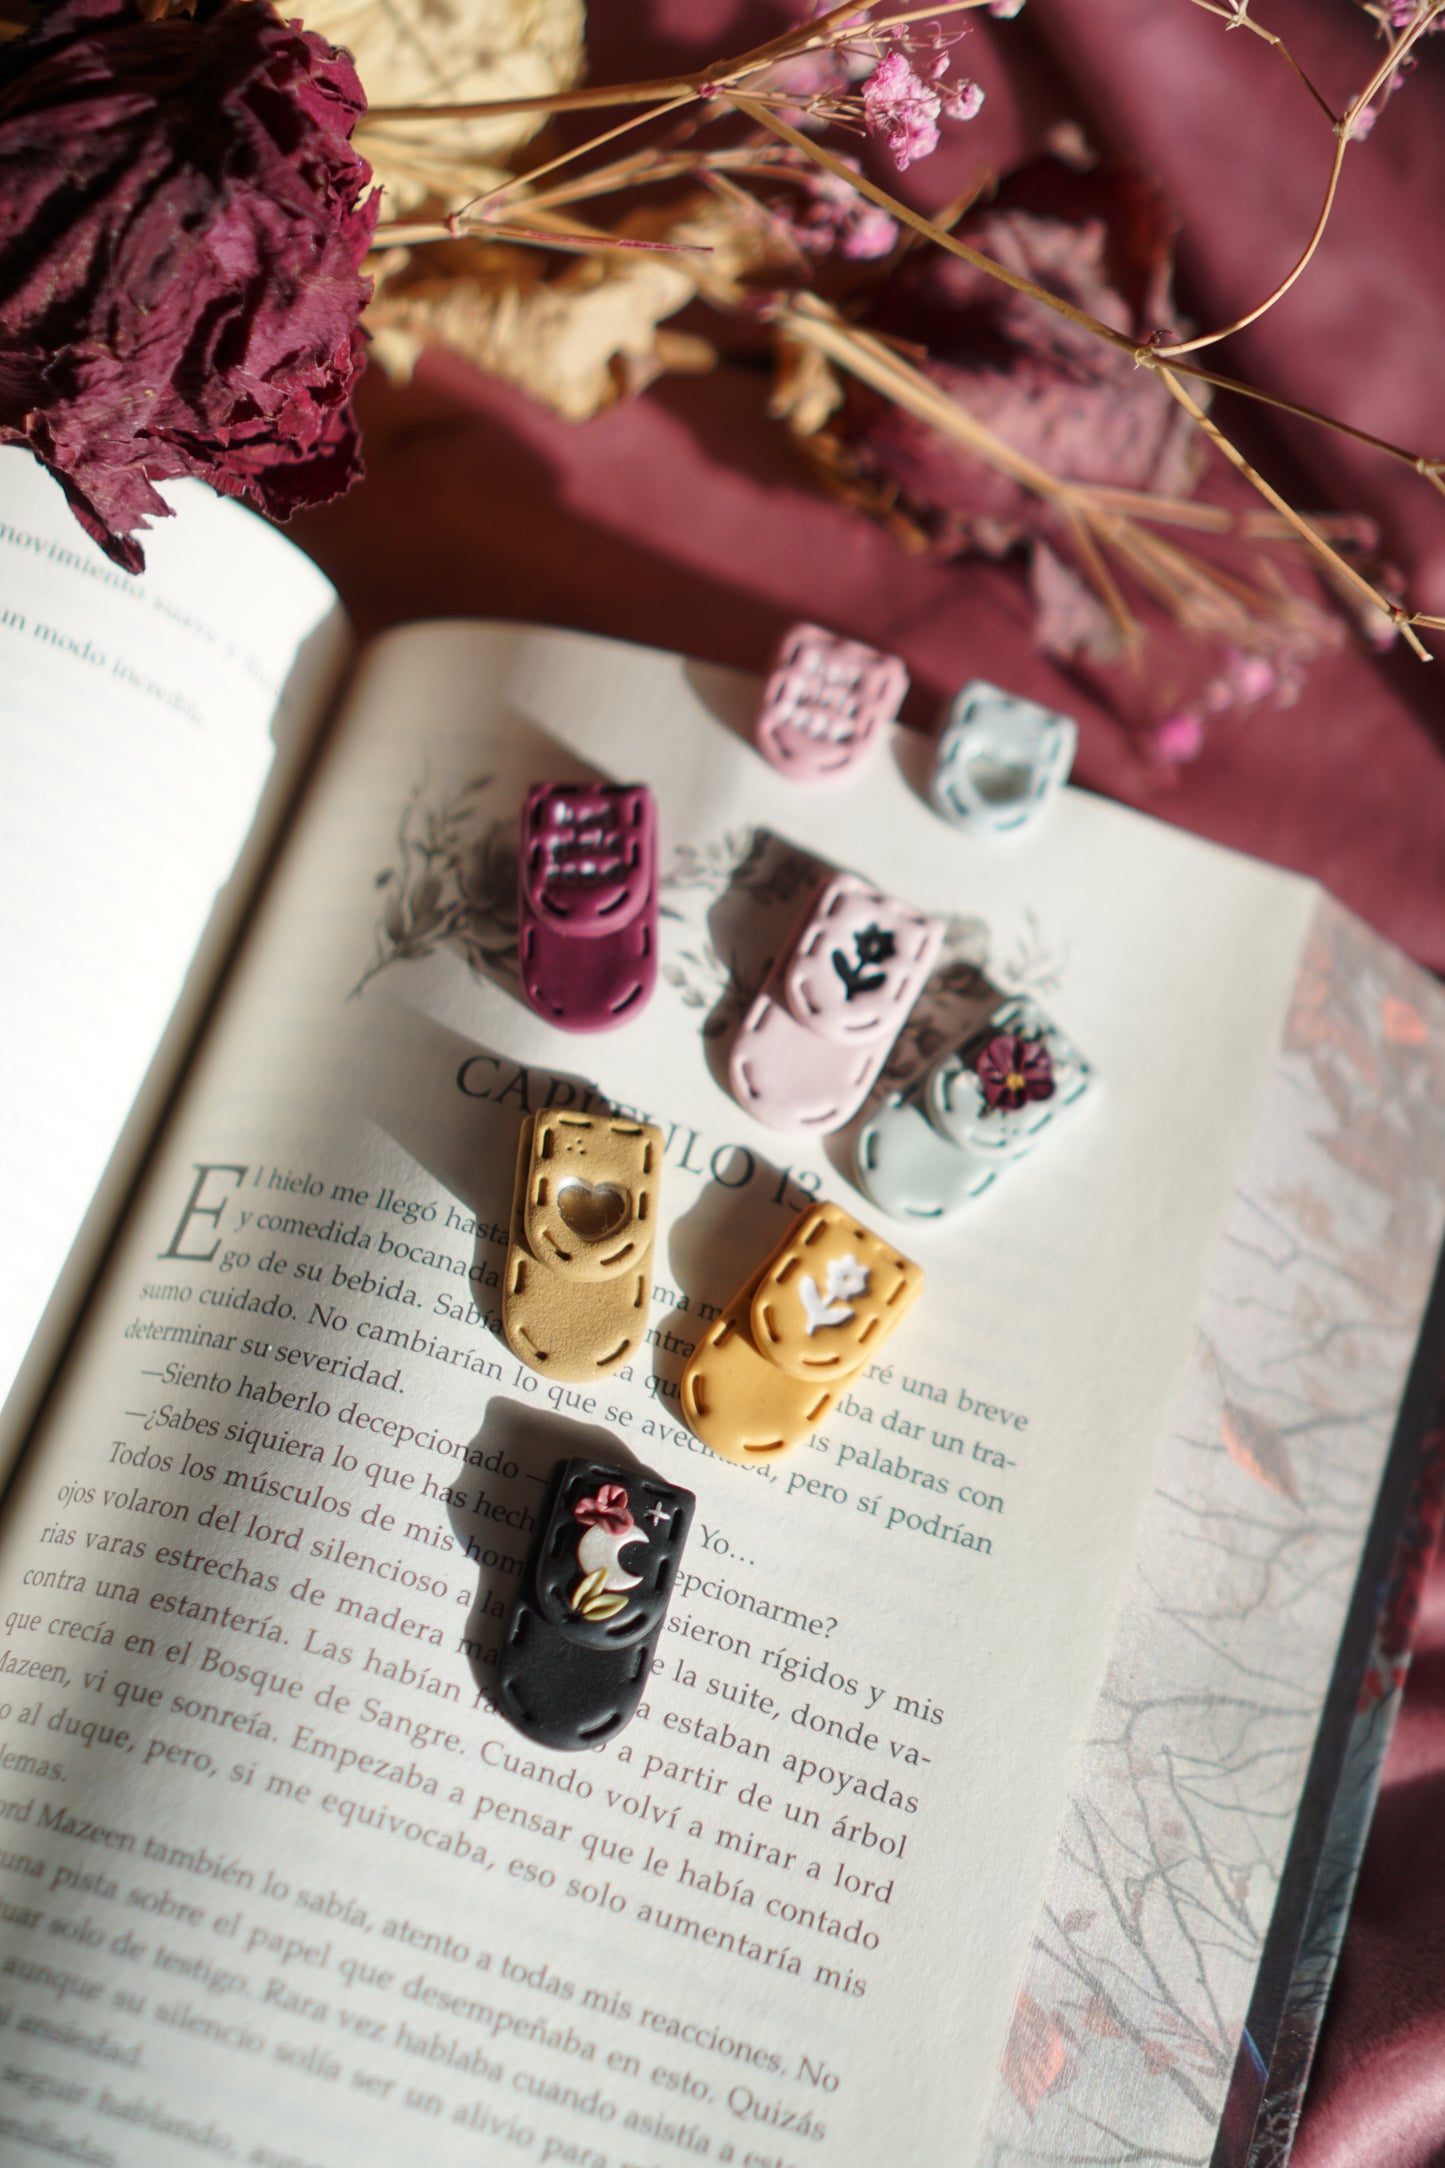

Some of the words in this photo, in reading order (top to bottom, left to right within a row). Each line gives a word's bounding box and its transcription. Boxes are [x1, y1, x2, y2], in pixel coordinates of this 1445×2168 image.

[124, 1317, 237, 1351] determinar
[240, 1338, 270, 1358] su
[274, 1344, 405, 1394] severidad.
[139, 1281, 192, 1302] sumo
[199, 1286, 298, 1320] cuidado.
[307, 1303, 348, 1331] No
[356, 1321, 503, 1381] cambiarían
[512, 1365, 538, 1393] lo
[548, 1384, 597, 1414] que
[605, 1403, 633, 1427] se
[785, 1470, 849, 1505] pero
[856, 1495, 883, 1516] sí
[884, 1505, 994, 1556] podrían
[219, 1250, 251, 1272] go
[257, 1251, 287, 1275] de
[294, 1262, 323, 1282] su
[331, 1265, 422, 1308] bebida.
[836, 1442, 950, 1494] palabras
[958, 1484, 1006, 1514] con
[234, 1210, 253, 1232] y
[257, 1212, 371, 1250] comedida
[378, 1232, 499, 1289] bocanada
[881, 1410, 925, 1441] dar
[931, 1430, 964, 1456] un
[971, 1440, 1017, 1470] tra-
[236, 1374, 331, 1418] haberlo
[338, 1402, 519, 1479] decepcionado
[267, 1171, 324, 1197] hielo
[330, 1184, 369, 1206] me
[375, 1188, 437, 1224] llegó
[444, 1206, 509, 1246] hasta
[901, 1374, 949, 1405] una
[957, 1387, 1029, 1432] breve
[57, 1481, 96, 1509] ojos
[103, 1488, 190, 1522] volaron
[198, 1505, 241, 1533] del
[245, 1515, 304, 1551] lord
[309, 1538, 448, 1598] silencioso
[456, 1589, 472, 1607] a
[672, 1659, 698, 1688] la
[706, 1678, 780, 1721] suite,
[791, 1704, 879, 1751] donde
[890, 1740, 932, 1766] va-
[109, 1441, 173, 1472] Todos
[179, 1453, 216, 1481] los
[222, 1469, 351, 1518] músculos
[361, 1504, 396, 1531] de
[403, 1522, 455, 1551] mis
[662, 1614, 751, 1659] sieron
[760, 1649, 858, 1695] rígidos
[865, 1686, 886, 1709] y
[894, 1694, 945, 1725] mis
[224, 1421, 325, 1462] siquiera
[331, 1445, 358, 1472] lo
[365, 1463, 415, 1490] que
[420, 1473, 469, 1508] has
[472, 1491, 537, 1532] hech
[672, 1569, 838, 1638] epcionarme?
[5, 1610, 42, 1636] que
[48, 1616, 115, 1646] crecía
[124, 1634, 156, 1657] en
[165, 1641, 193, 1665] el
[200, 1647, 304, 1699] Bosque
[314, 1685, 351, 1714] de
[360, 1698, 465, 1755] Sangre.
[480, 1740, 593, 1799] Cuando
[606, 1789, 682, 1830] volví
[688, 1820, 704, 1838] a
[715, 1829, 797, 1871] mirar
[806, 1861, 822, 1880] a
[833, 1863, 895, 1904] lord
[23, 1569, 86, 1593] contra
[95, 1579, 140, 1604] una
[149, 1592, 289, 1645] estantería.
[303, 1628, 353, 1665] Las
[362, 1648, 461, 1702] habían
[617, 1745, 634, 1764] a
[642, 1755, 728, 1796] partir
[738, 1783, 773, 1812] de
[784, 1802, 821, 1830] un
[831, 1815, 908, 1860] árbol
[39, 1522, 77, 1545] rias
[86, 1531, 147, 1558] varas
[155, 1547, 280, 1593] estrechas
[290, 1578, 326, 1606] de
[335, 1595, 444, 1647] madera
[663, 1712, 770, 1762] estaban
[782, 1753, 919, 1814] apoyadas
[18, 1702, 43, 1725] al
[47, 1708, 136, 1754] duque,
[142, 1738, 218, 1778] pero,
[229, 1761, 257, 1787] si
[265, 1774, 311, 1804] me
[321, 1793, 495, 1871] equivocaba,
[508, 1858, 555, 1888] eso
[566, 1877, 627, 1914] solo
[637, 1903, 802, 1976] aumentaría
[813, 1964, 868, 1998] mis
[84, 1669, 109, 1693] vi
[113, 1680, 163, 1707] que
[170, 1695, 278, 1743] sonreía.
[290, 1725, 439, 1796] Empezaba
[449, 1786, 465, 1805] a
[472, 1795, 572, 1842] pensar
[581, 1833, 634, 1864] que
[642, 1847, 669, 1877] le
[677, 1859, 755, 1908] había
[766, 1899, 880, 1950] contado
[36, 1804, 137, 1852] Mazeen
[142, 1837, 256, 1890] también
[260, 1869, 289, 1900] lo
[294, 1889, 373, 1934] sabía,
[381, 1918, 470, 1964] atento
[475, 1951, 493, 1971] a
[499, 1955, 576, 2001] todas
[579, 1987, 633, 2021] mis
[638, 2007, 787, 2076] reacciones.
[796, 2056, 841, 2094] No
[49, 1865, 120, 1899] pista
[126, 1886, 205, 1927] sobre
[213, 1912, 243, 1938] el
[246, 1926, 332, 1968] papel
[339, 1957, 395, 1990] que
[402, 1974, 597, 2063] desempeñaba
[606, 2049, 642, 2078] en
[651, 2066, 714, 2104] esto.
[727, 2085, 827, 2142] Quizás
[109, 1929, 147, 1961] de
[152, 1944, 251, 1998] testigo.
[262, 1976, 329, 2023] Rara
[337, 2007, 389, 2044] vez
[393, 2020, 505, 2084] hablaba
[511, 2069, 617, 2123] cuando
[622, 2110, 712, 2157] asistía
[111, 1988, 146, 2016] su
[153, 2003, 268, 2053] silencio
[402, 2085, 445, 2118] un
[450, 2100, 536, 2149] alivio
